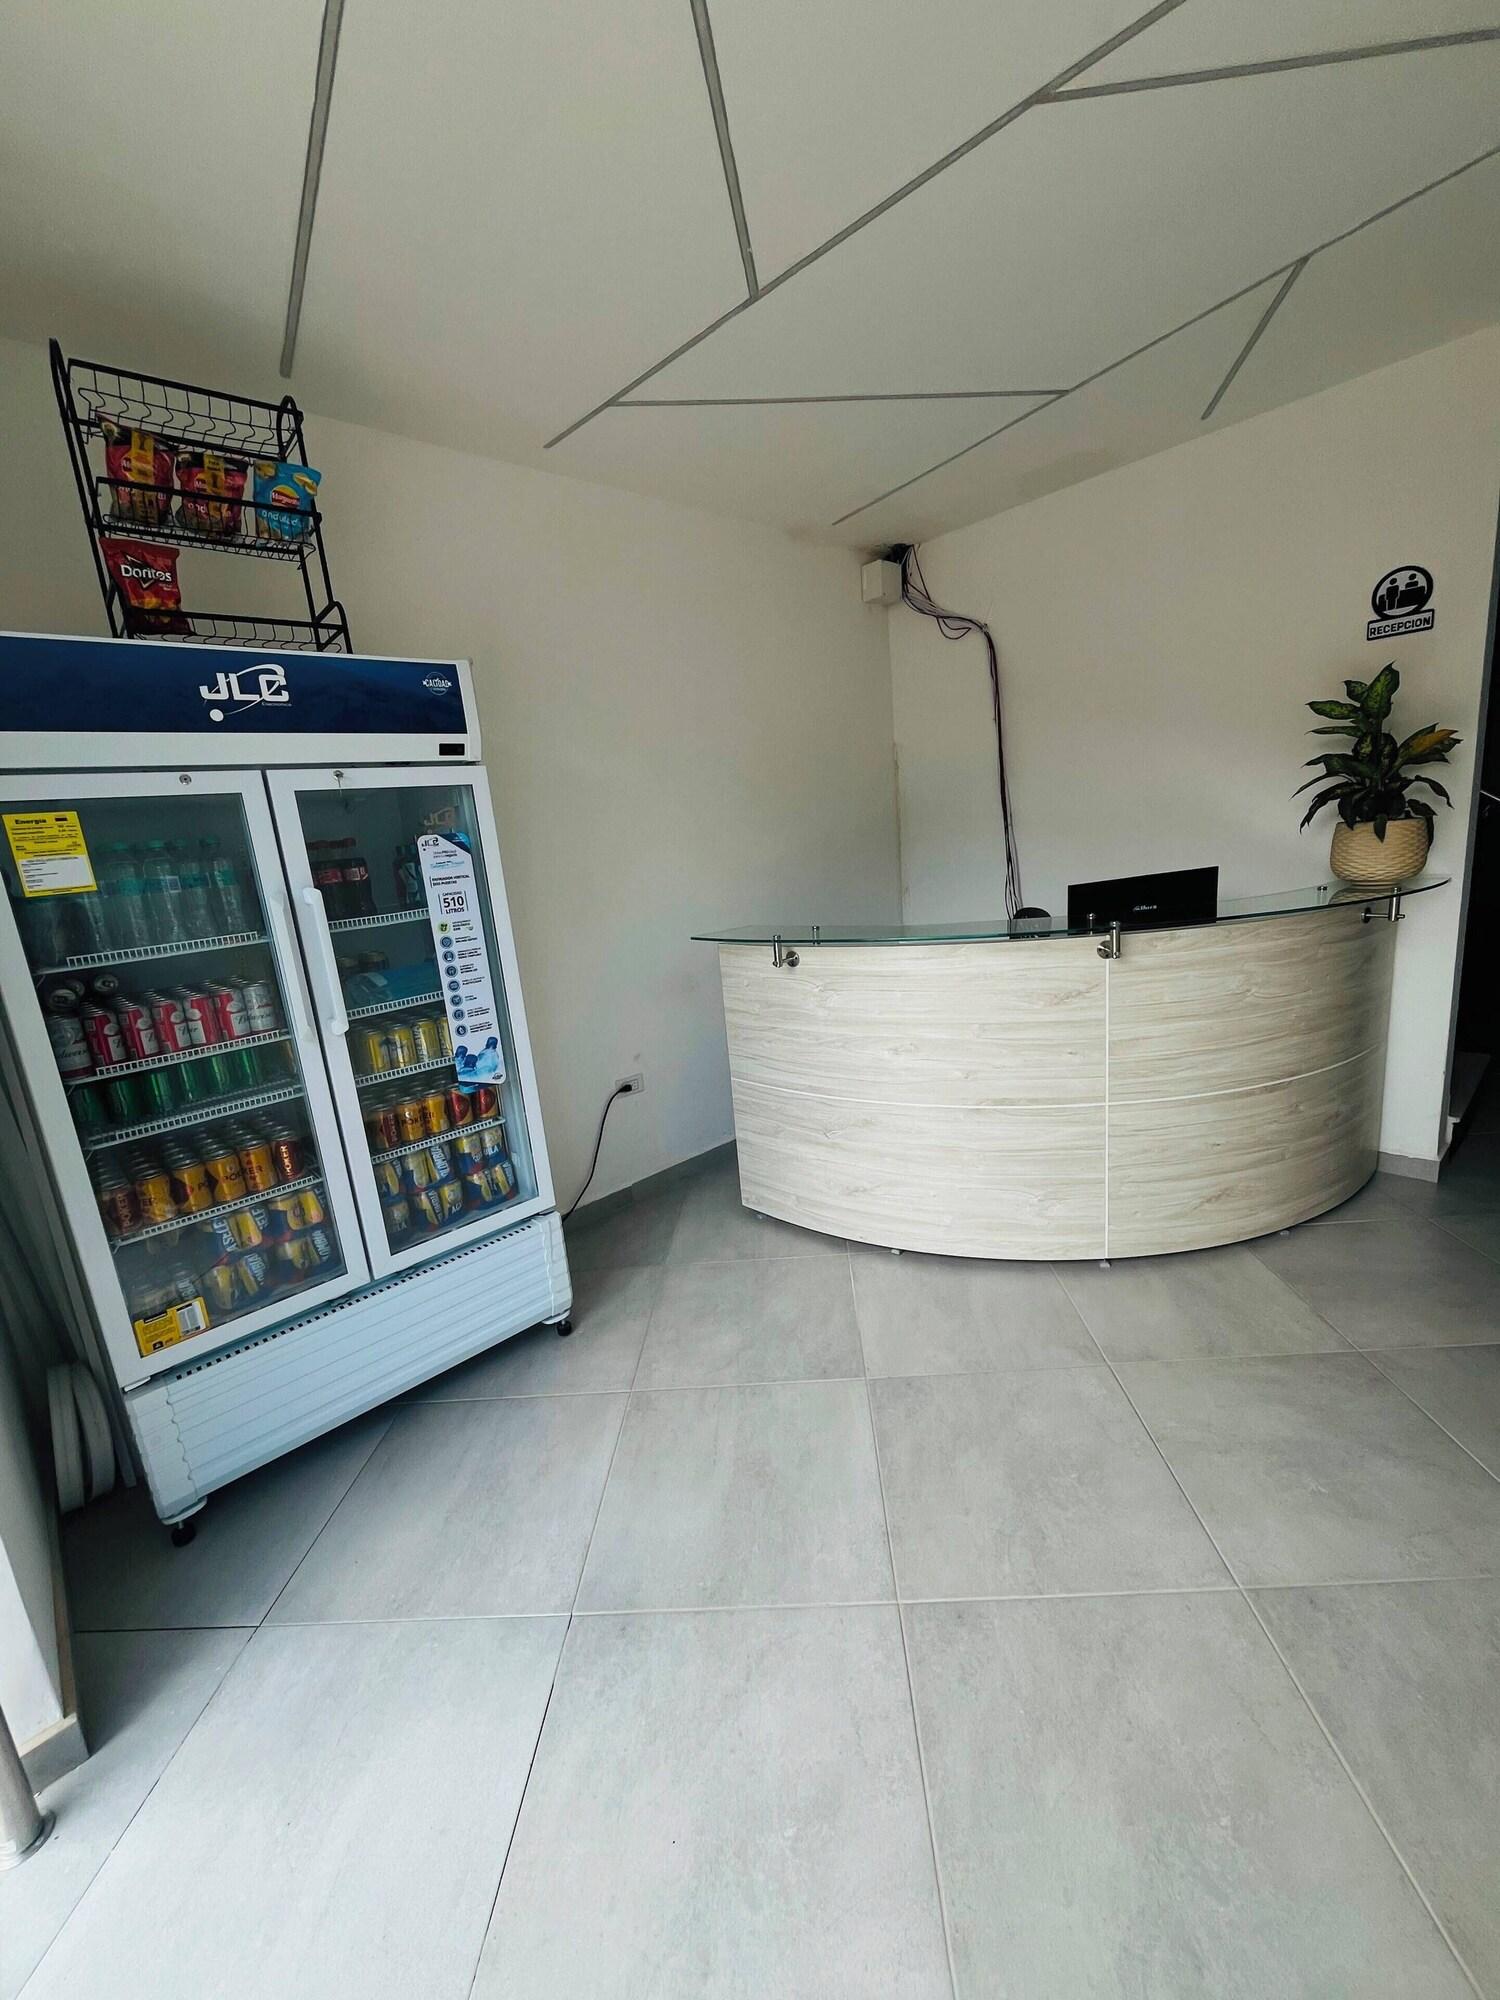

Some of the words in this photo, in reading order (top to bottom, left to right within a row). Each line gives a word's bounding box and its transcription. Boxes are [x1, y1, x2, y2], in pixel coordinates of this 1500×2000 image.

[120, 564, 172, 582] Doritos
[1369, 616, 1431, 637] RECEPCION
[199, 664, 290, 703] JLC
[443, 896, 465, 909] 510
[445, 907, 465, 915] LITROS
